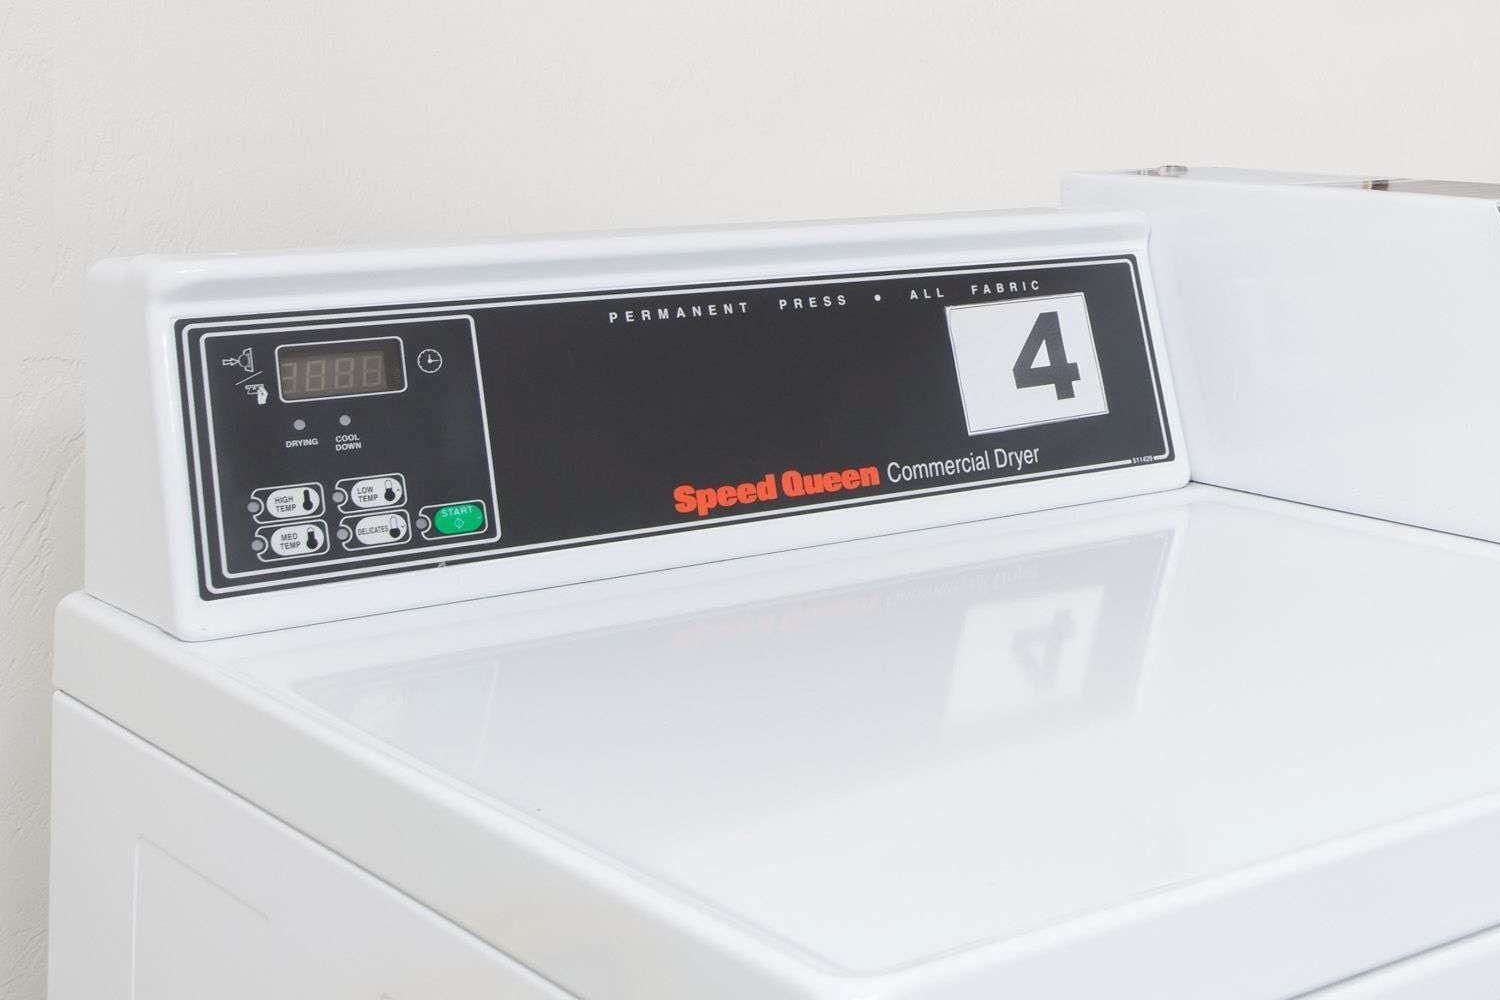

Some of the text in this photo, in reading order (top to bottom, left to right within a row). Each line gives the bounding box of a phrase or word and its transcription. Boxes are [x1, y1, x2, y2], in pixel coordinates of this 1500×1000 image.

[608, 280, 1041, 323] PERMANENT PRESS ALL FABRIC
[1012, 311, 1081, 401] 4
[285, 438, 319, 448] DRYING
[335, 434, 360, 443] COOL
[335, 442, 362, 451] DOWN
[673, 446, 1040, 516] Speed Queen Commercial Dryer
[357, 487, 374, 495] LOW
[275, 496, 294, 504] HIGH
[358, 494, 378, 502] TEMP
[276, 504, 297, 512] TEMP
[441, 506, 473, 518] START
[357, 526, 389, 536] DELICATES
[281, 533, 298, 541] MED
[280, 541, 301, 550] TEMP
